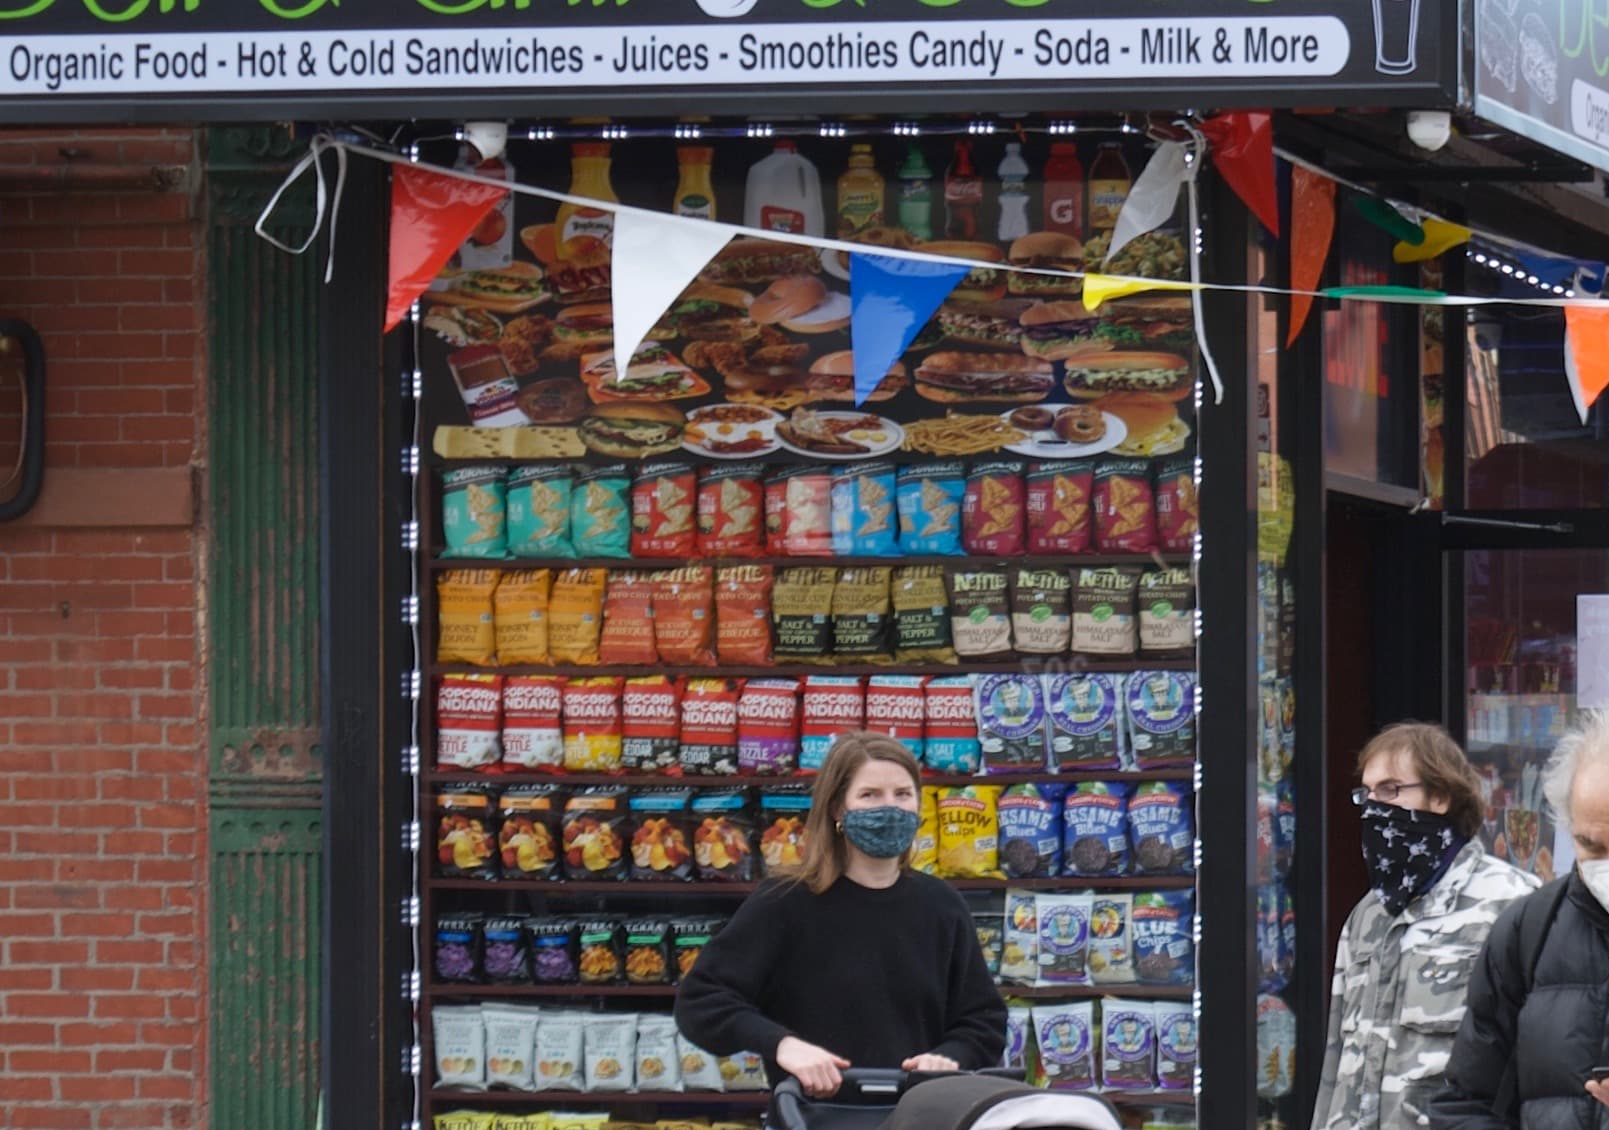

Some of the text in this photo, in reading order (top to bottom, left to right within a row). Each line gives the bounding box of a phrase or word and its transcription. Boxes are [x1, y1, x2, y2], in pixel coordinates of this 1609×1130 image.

[9, 26, 1319, 91] Organic Food Hot & Cold Sandwiches Juices Smoothies Candy Soda Milk & More
[1051, 199, 1074, 224] G
[563, 693, 617, 705] OPCORN
[927, 694, 973, 707] OPCOR
[563, 705, 617, 718] NDIANA
[622, 705, 677, 718] NDIANA
[738, 705, 796, 719] NDIANA
[681, 712, 737, 726] NDIANA
